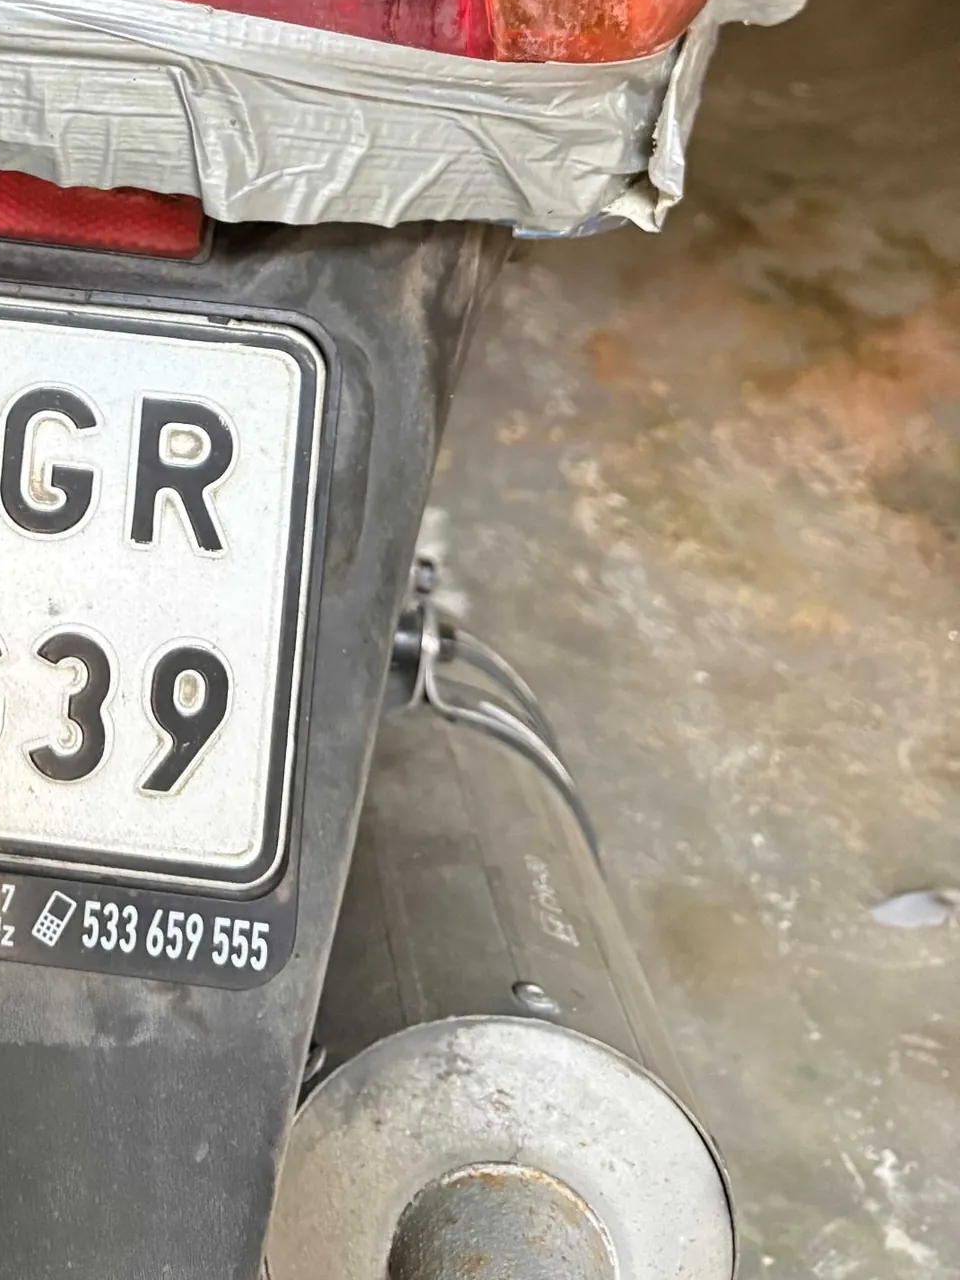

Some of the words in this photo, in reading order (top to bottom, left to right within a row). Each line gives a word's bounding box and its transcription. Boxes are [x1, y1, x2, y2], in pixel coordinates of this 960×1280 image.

[82, 900, 138, 953] 533
[145, 908, 204, 961] 659
[211, 916, 270, 972] 555
